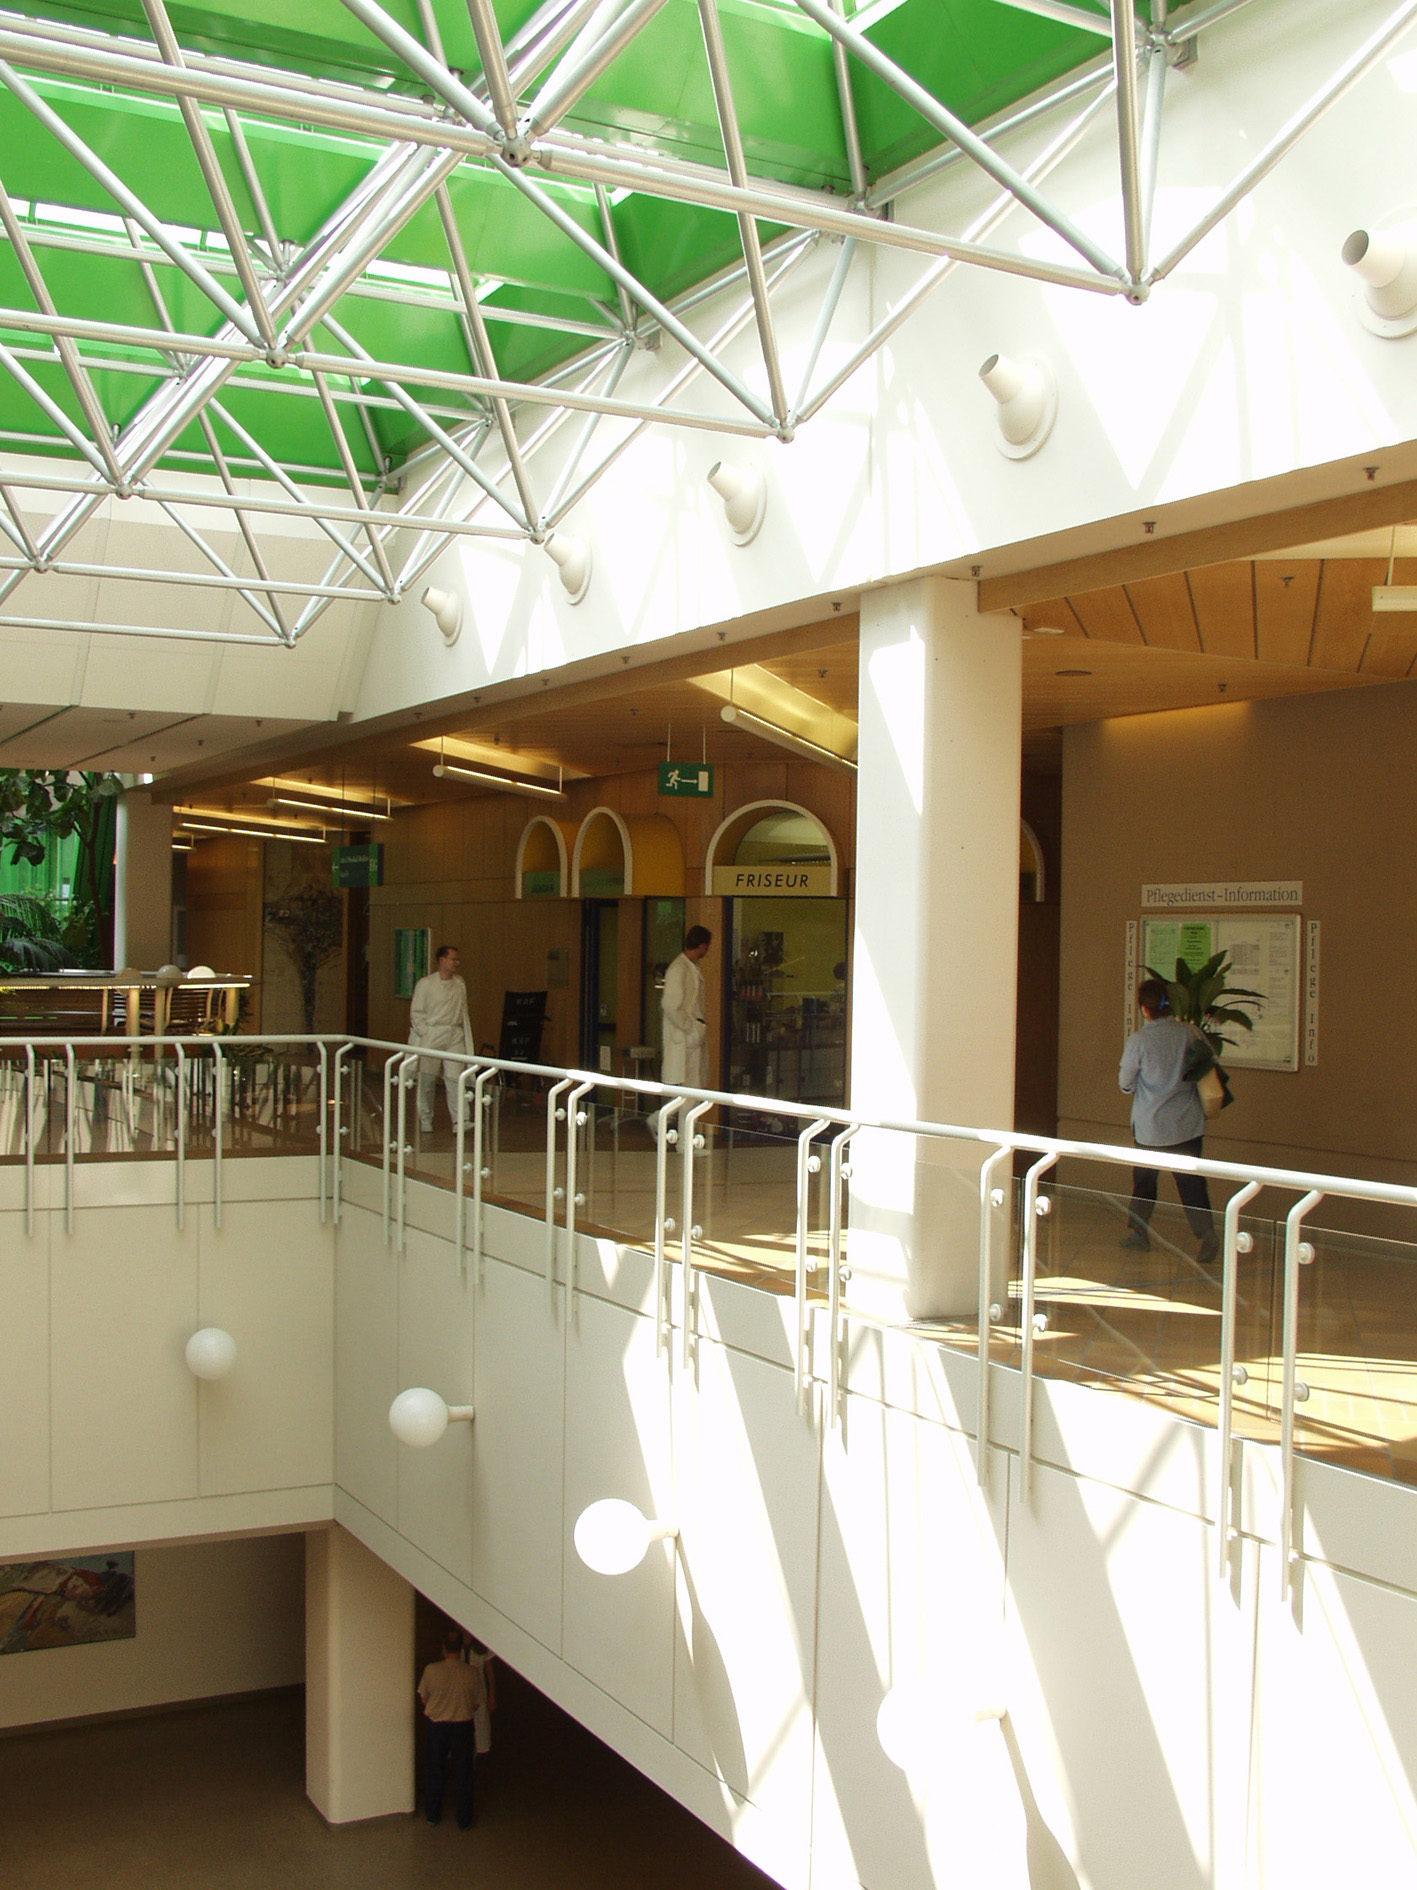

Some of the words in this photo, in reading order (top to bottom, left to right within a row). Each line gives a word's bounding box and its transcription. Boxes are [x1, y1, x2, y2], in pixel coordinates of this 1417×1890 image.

[735, 873, 809, 888] FRISEUR
[1126, 922, 1135, 991] Pflege
[1309, 922, 1318, 999] Pflege
[1125, 1003, 1134, 1038] Inf
[1307, 1013, 1316, 1063] Info
